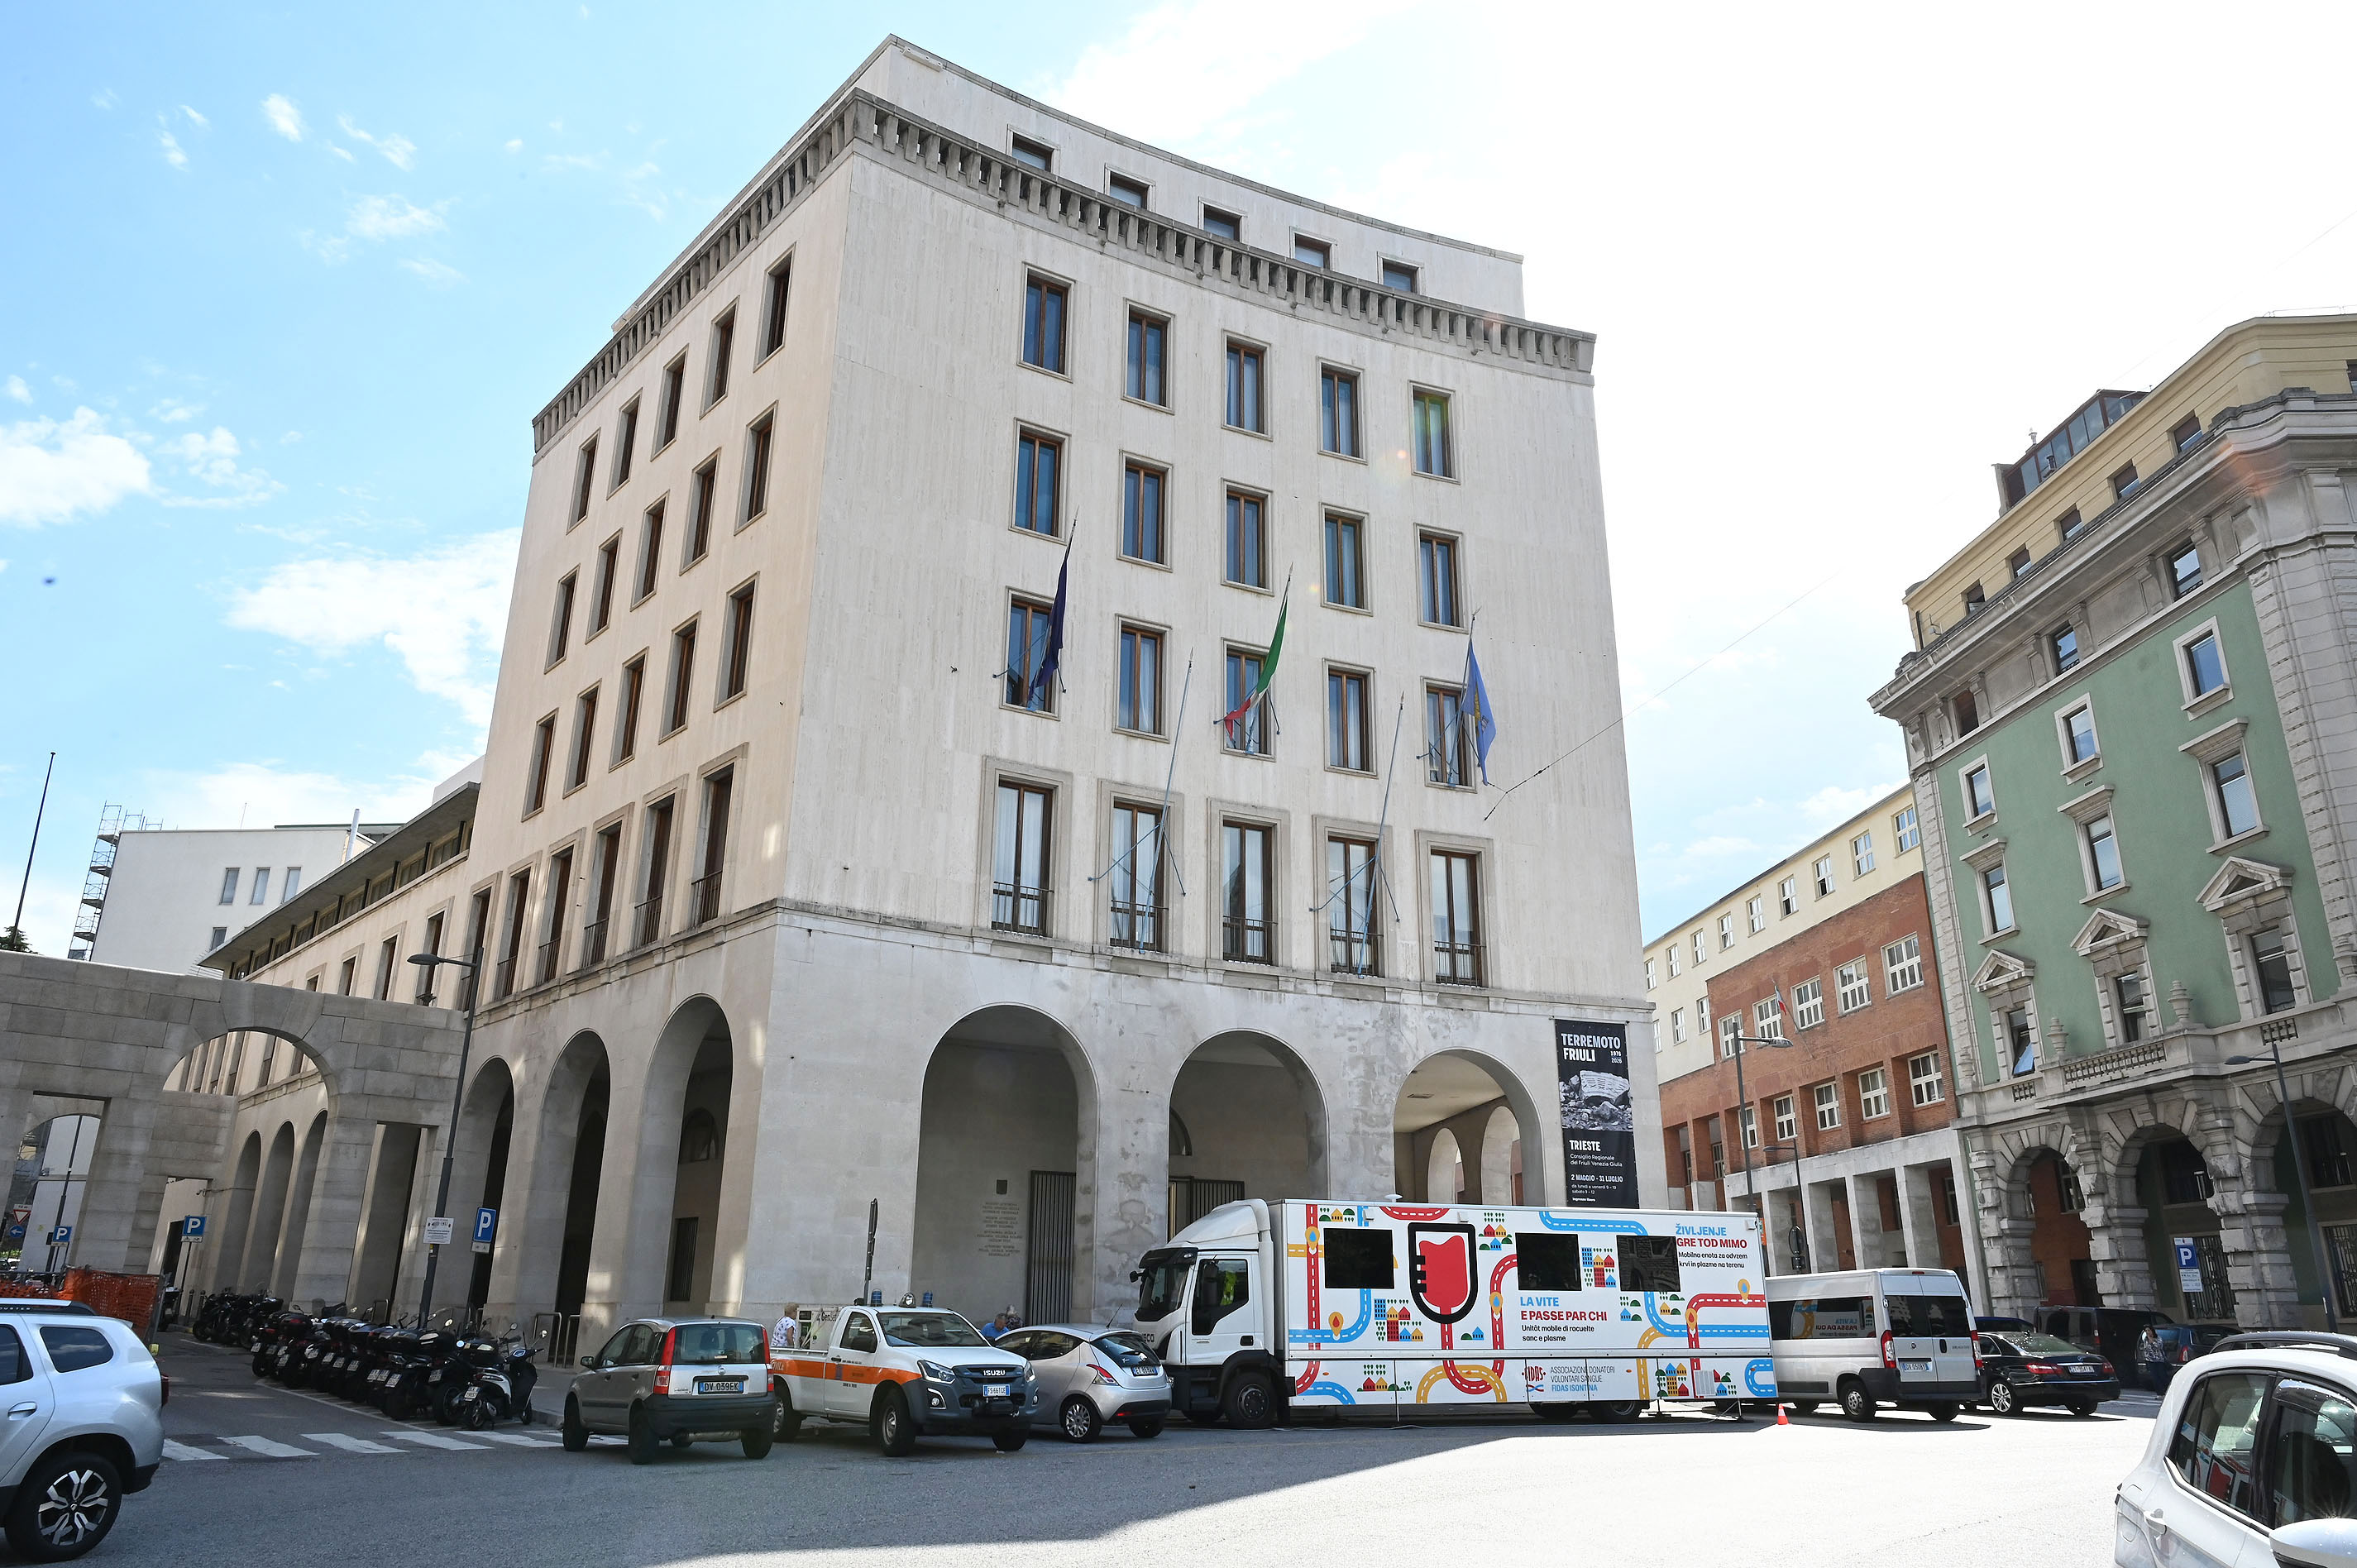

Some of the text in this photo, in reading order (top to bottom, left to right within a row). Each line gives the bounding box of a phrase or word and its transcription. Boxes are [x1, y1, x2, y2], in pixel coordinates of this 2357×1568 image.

[1561, 1033, 1621, 1049] TERREMOTO
[1563, 1048, 1596, 1062] FRIULI
[1569, 1140, 1601, 1151] TRIESTE
[186, 1218, 201, 1233] P
[477, 1212, 491, 1237] P
[1676, 1223, 1727, 1236] ŽIVLJENJE
[55, 1228, 67, 1240] P
[1676, 1238, 1747, 1248] GRE TOD MIMO
[2179, 1248, 2192, 1265] P
[1520, 1297, 1559, 1307] LA VITE
[1521, 1311, 1607, 1321] E PASSE PAR CHI
[705, 1382, 714, 1391] DV
